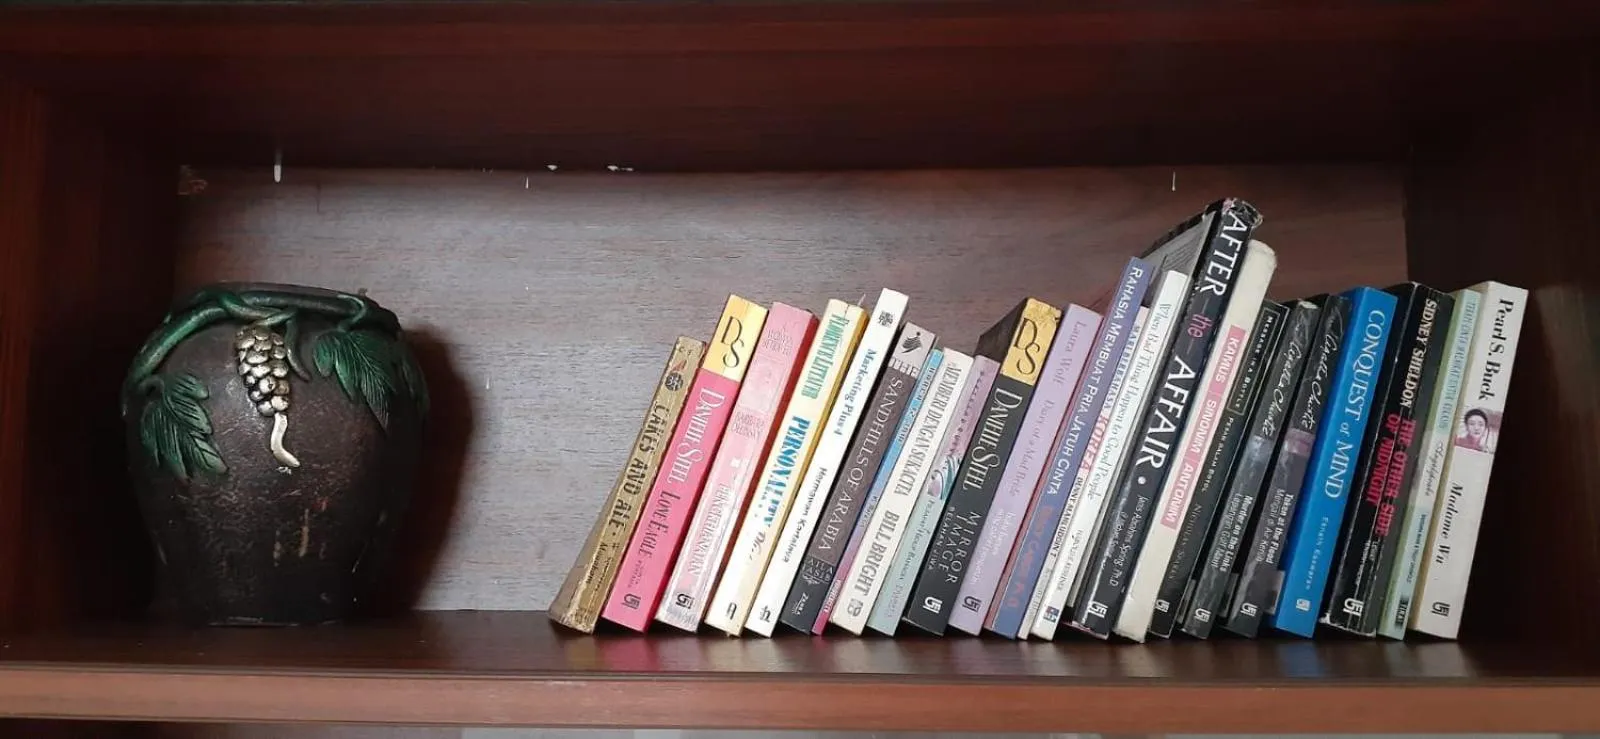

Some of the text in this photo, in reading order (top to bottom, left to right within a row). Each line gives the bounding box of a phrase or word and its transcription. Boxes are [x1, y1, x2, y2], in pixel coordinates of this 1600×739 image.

[817, 314, 849, 358] FLORENCE
[1135, 211, 1246, 467] AFTER the AFFAIR
[1142, 333, 1159, 354] Bad
[1150, 303, 1172, 330] When
[1254, 315, 1273, 353] MESSAGE
[844, 348, 876, 402] Marketing
[1052, 320, 1087, 384] Laura Wolf
[1400, 298, 1437, 407] SIDNEY SHELDON
[1478, 299, 1514, 399] Pearl S. Buck
[1046, 266, 1143, 494] RAHASIA MEMBUAT PRIA JATUH CINTA
[1115, 384, 1139, 422] Happen
[1234, 376, 1251, 407] BOTTLE
[1261, 340, 1301, 436] Agatha Christie
[1300, 333, 1337, 429] Agatha Christie
[1324, 310, 1384, 498] CONQUEST of MIND
[837, 403, 853, 426] Plus
[856, 377, 902, 466] SANDHILLS
[893, 363, 961, 495] MEMBERI DENGAN SUKACITA
[978, 387, 1022, 446] DANIELLE
[1111, 423, 1122, 435] to
[1165, 337, 1239, 522] KAMUS SINONIM ANTONIM
[608, 404, 669, 531] CAKES AND ALE
[638, 388, 724, 555] DANIELLE STEEL LONE EAGLE
[962, 445, 999, 489] STEEL
[1018, 448, 1035, 470] Mad
[1079, 416, 1108, 472] KOREA
[1099, 436, 1119, 466] Good
[1367, 412, 1401, 507] OF MIDNIGHT
[802, 467, 827, 516] Hermawan
[846, 467, 863, 490] OF
[1008, 470, 1026, 496] Bride
[1087, 466, 1109, 500] People
[1373, 416, 1416, 537] THE OTHER SIDE
[818, 491, 851, 549] ARABIA
[875, 510, 899, 540] BILL
[928, 506, 955, 570] BELAHAN JIWA
[938, 514, 968, 570] IMAGE
[945, 511, 981, 582] MIRROR
[1219, 495, 1253, 571] Murder on the Links
[1265, 493, 1294, 563] Taken at the Flood
[1435, 485, 1463, 563] Madame Wu
[854, 541, 886, 595] BRIGHT
